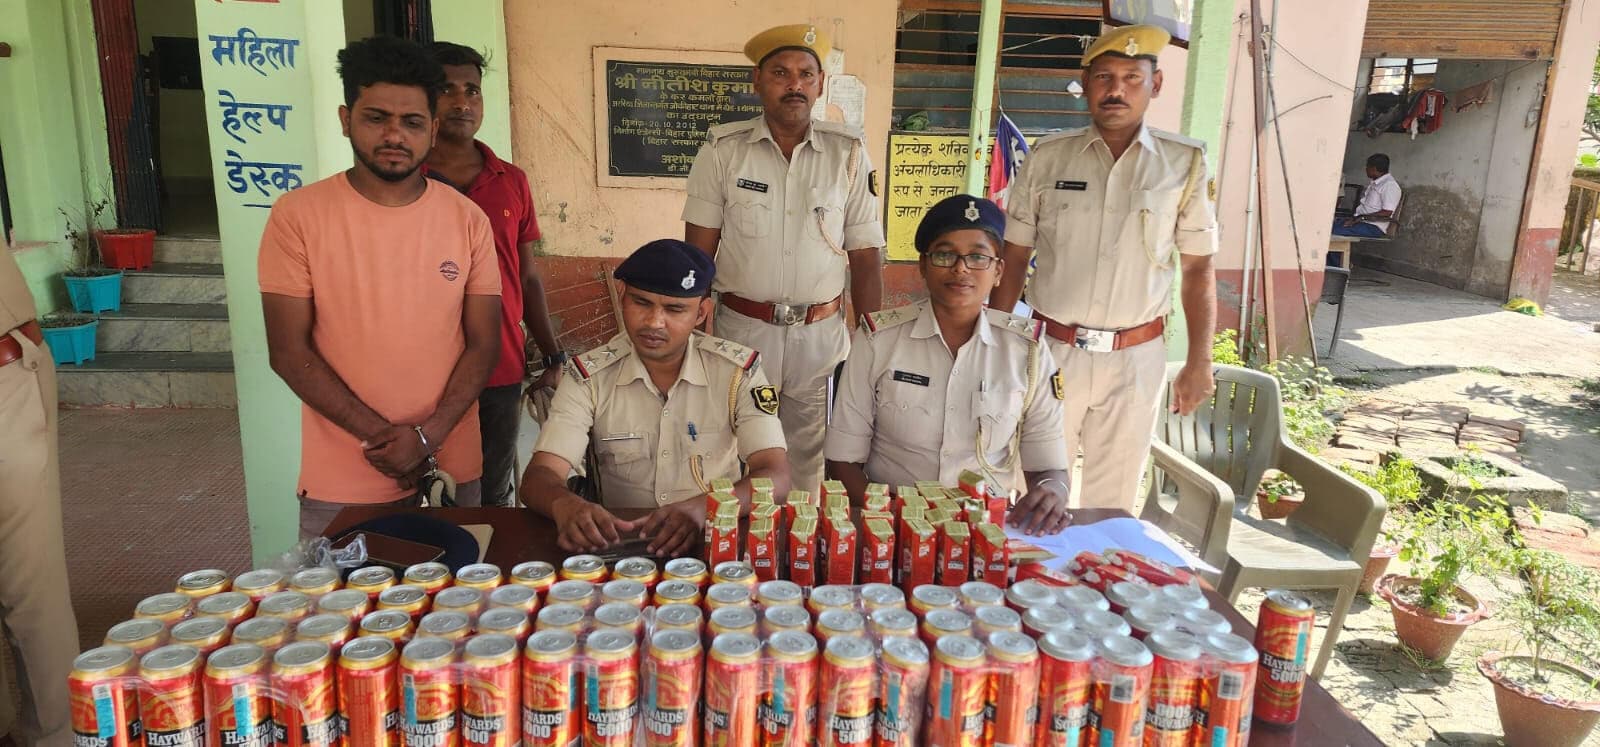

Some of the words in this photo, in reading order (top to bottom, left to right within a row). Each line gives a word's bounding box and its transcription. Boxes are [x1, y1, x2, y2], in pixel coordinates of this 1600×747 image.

[208, 27, 300, 76] महिला
[615, 73, 638, 89] श्री
[640, 75, 708, 92] नीतीश
[711, 81, 755, 95] कुमा
[218, 89, 293, 144] हेल्प
[895, 138, 932, 157] प्रत्येक
[938, 140, 969, 157] शनिव
[224, 149, 303, 197] डेस्क
[894, 160, 966, 178] अंचलाधिकारी
[893, 185, 910, 198] रूप
[913, 181, 923, 198] से
[929, 185, 959, 197] जनता
[895, 205, 922, 219] जाता
[148, 722, 205, 746] HAYWAR
[464, 726, 489, 744] 000
[525, 723, 552, 738] 000
[647, 717, 672, 736] 000
[73, 734, 108, 747] ARDS
